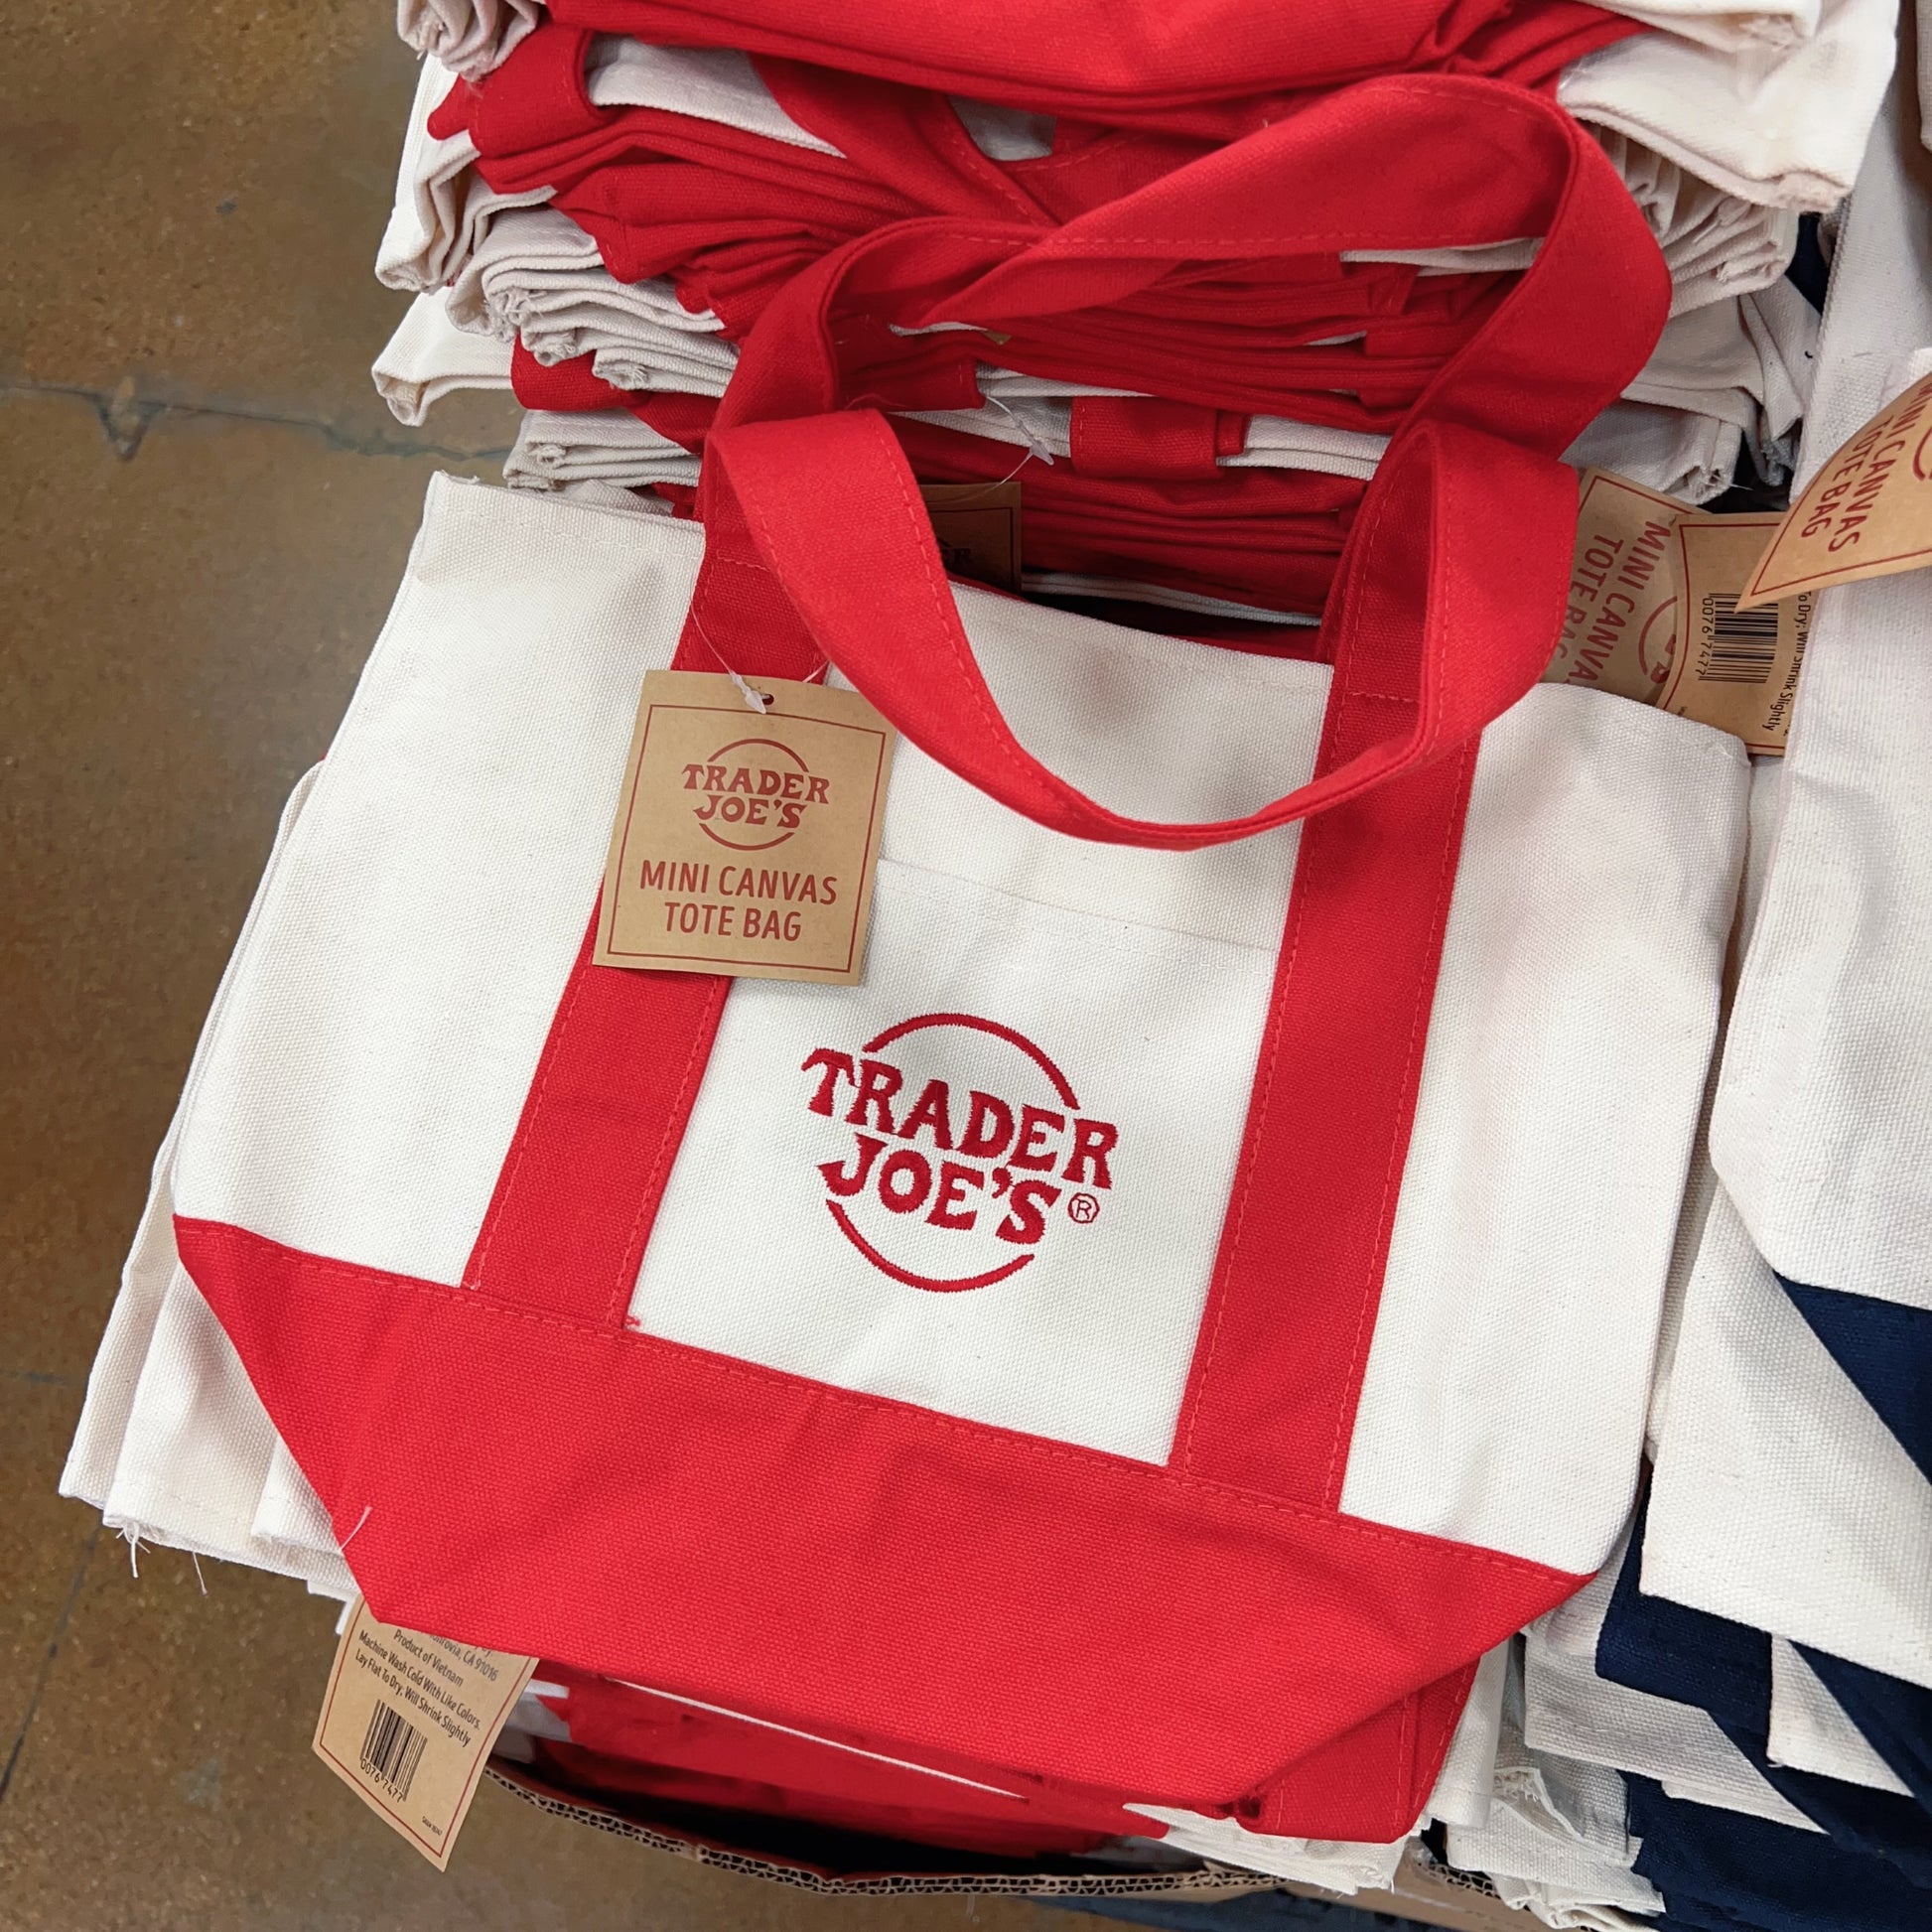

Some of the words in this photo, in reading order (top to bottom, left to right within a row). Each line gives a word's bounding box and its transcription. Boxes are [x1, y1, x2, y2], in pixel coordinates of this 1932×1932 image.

[1833, 415, 1894, 483] TOTE
[1801, 482, 1853, 537] BAG
[1828, 440, 1906, 552] CANVAS
[1570, 534, 1624, 602] TOTE
[1617, 521, 1672, 591] MINI
[1562, 593, 1635, 684] CANVA
[1702, 598, 1715, 634] 0076
[1793, 605, 1811, 628] Dry;
[1695, 642, 1713, 675] 7477
[1762, 692, 1793, 731] Slightly
[682, 763, 830, 804] TRADER
[693, 794, 807, 829] JOE'S
[640, 860, 710, 894] MINI
[719, 866, 838, 905] CANVAS
[664, 901, 735, 936] TOTE
[743, 907, 801, 941] BAG
[801, 1047, 1119, 1190] TRADER
[817, 1132, 1062, 1245] JOE'S
[359, 1629, 388, 1659] Machine
[388, 1651, 407, 1674] Wash
[406, 1666, 424, 1686] Cold
[424, 1678, 442, 1699] With
[441, 1693, 456, 1712] Like
[456, 1703, 481, 1730] Colors.
[393, 1629, 423, 1658] Product
[422, 1652, 434, 1665] of
[432, 1656, 464, 1687] Vietnam
[463, 1650, 476, 1666] CA
[475, 1658, 498, 1682] 91016
[355, 1649, 367, 1669] Lay
[367, 1658, 382, 1678] Flat
[381, 1669, 390, 1683] To
[404, 1686, 419, 1706] Will
[418, 1697, 443, 1724] Shrink
[441, 1716, 472, 1748] Slightly
[360, 1758, 380, 1783] 0076
[382, 1779, 403, 1803] 7477
